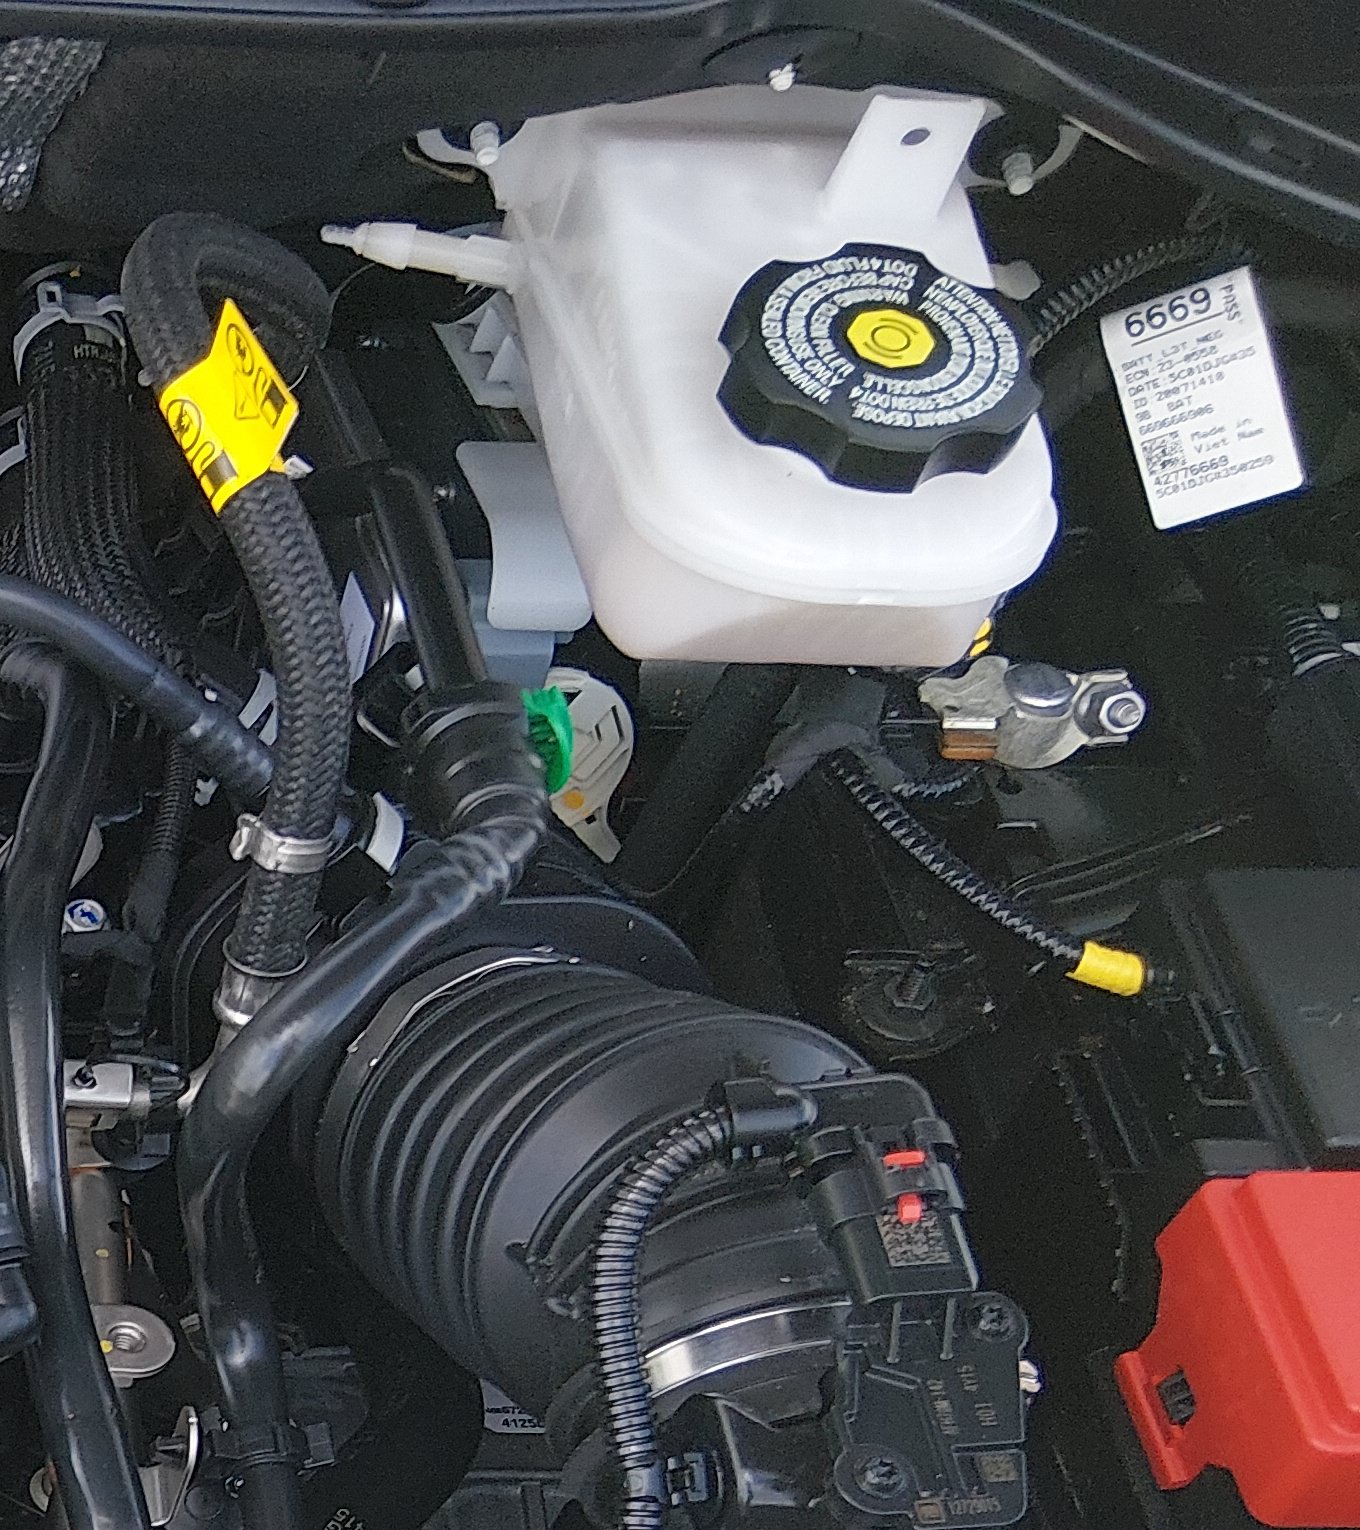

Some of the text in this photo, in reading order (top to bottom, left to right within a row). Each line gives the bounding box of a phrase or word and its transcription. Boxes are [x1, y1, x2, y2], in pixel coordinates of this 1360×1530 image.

[882, 258, 919, 278] DOT
[1124, 288, 1211, 338] 6669
[803, 358, 847, 388] ONLY
